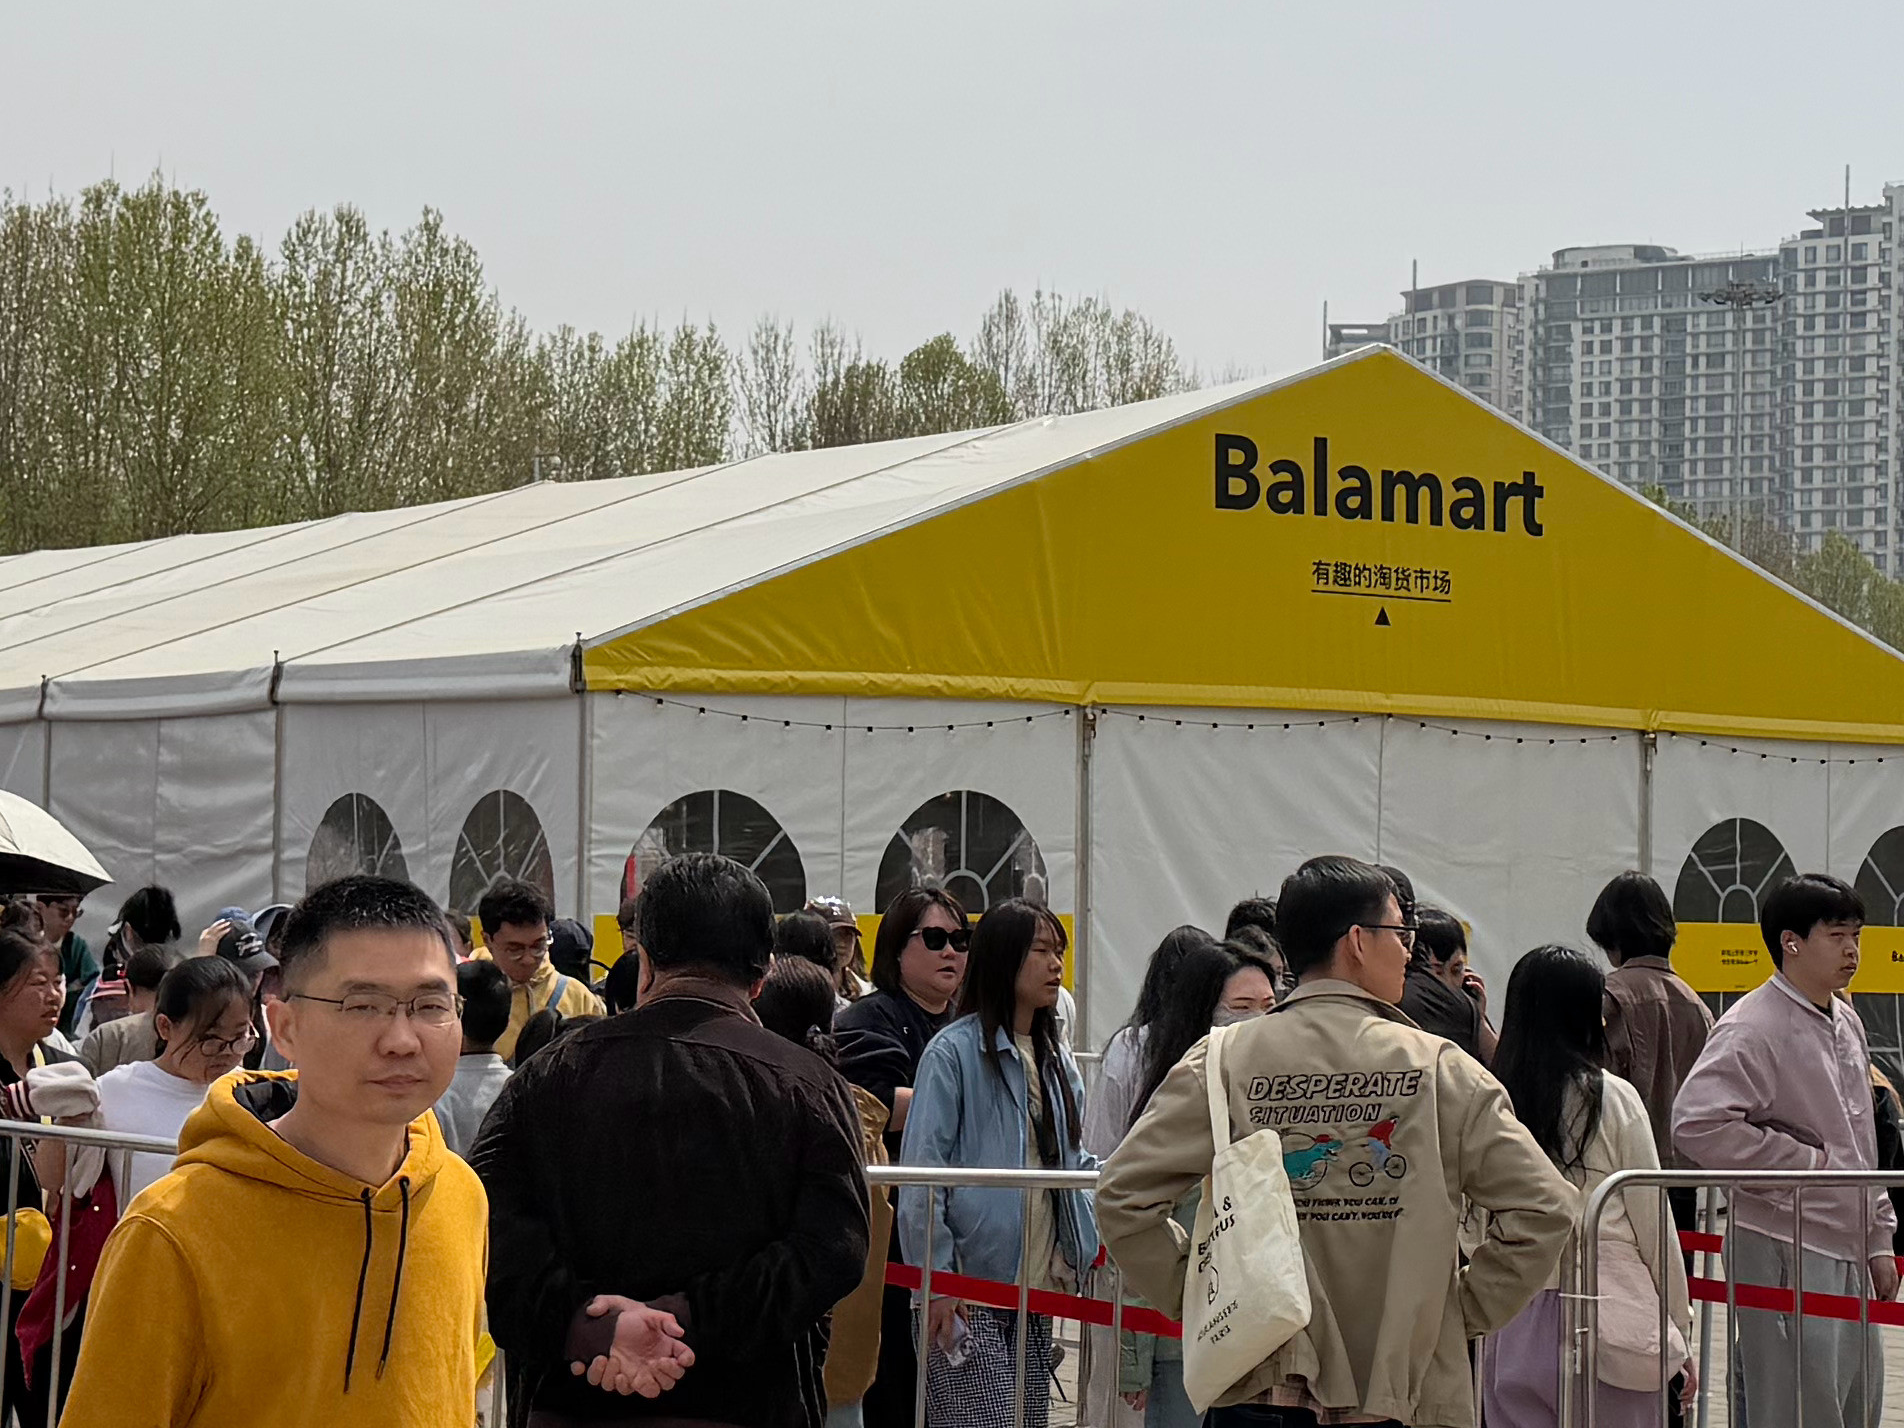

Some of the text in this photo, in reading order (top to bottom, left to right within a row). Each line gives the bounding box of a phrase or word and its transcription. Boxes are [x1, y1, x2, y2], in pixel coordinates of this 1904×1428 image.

[1214, 432, 1544, 537] Balamart
[1311, 560, 1452, 596] 有趣的淘货市场
[1247, 1070, 1423, 1101] DESPERATE
[1249, 1103, 1382, 1126] SITUATION
